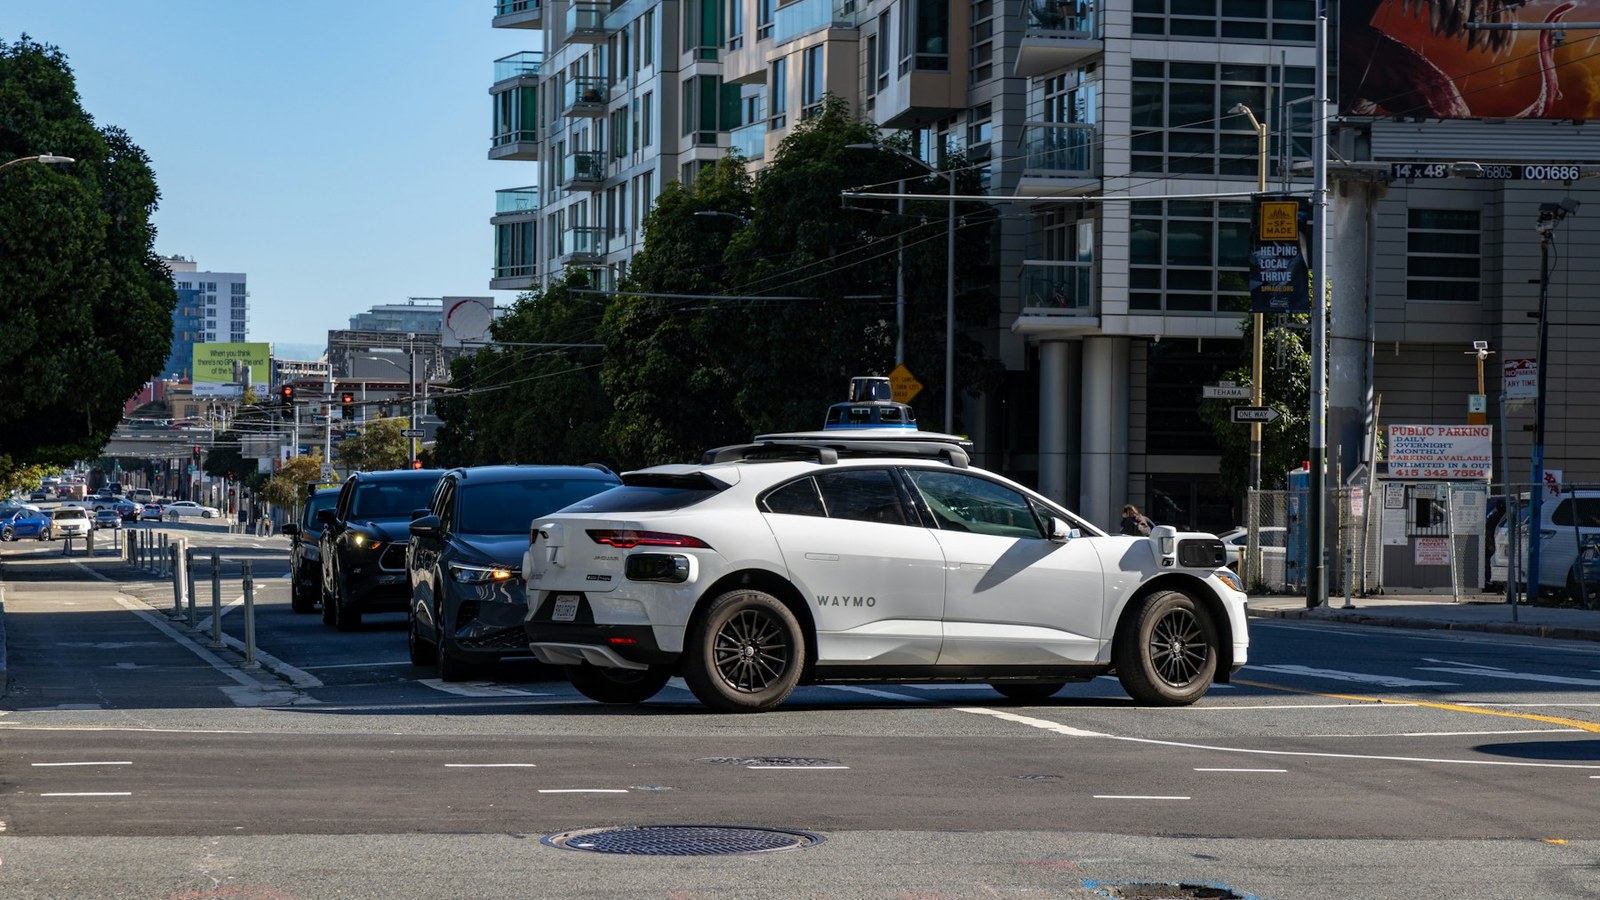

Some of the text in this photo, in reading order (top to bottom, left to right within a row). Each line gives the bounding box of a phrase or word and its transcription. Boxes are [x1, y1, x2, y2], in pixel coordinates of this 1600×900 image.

[1525, 166, 1579, 180] 001686
[1260, 246, 1298, 256] HELPING
[1260, 259, 1288, 269] LOCAL
[1260, 271, 1292, 282] THRIVE
[1505, 369, 1516, 377] NO
[1522, 379, 1537, 387] TIME
[1213, 388, 1242, 396] TEHAMA
[1239, 410, 1268, 418] ONE WAY
[1391, 426, 1489, 437] PUBLIC PARKING
[1395, 469, 1484, 477] 415 342 7554
[816, 595, 876, 608] WAYMO
